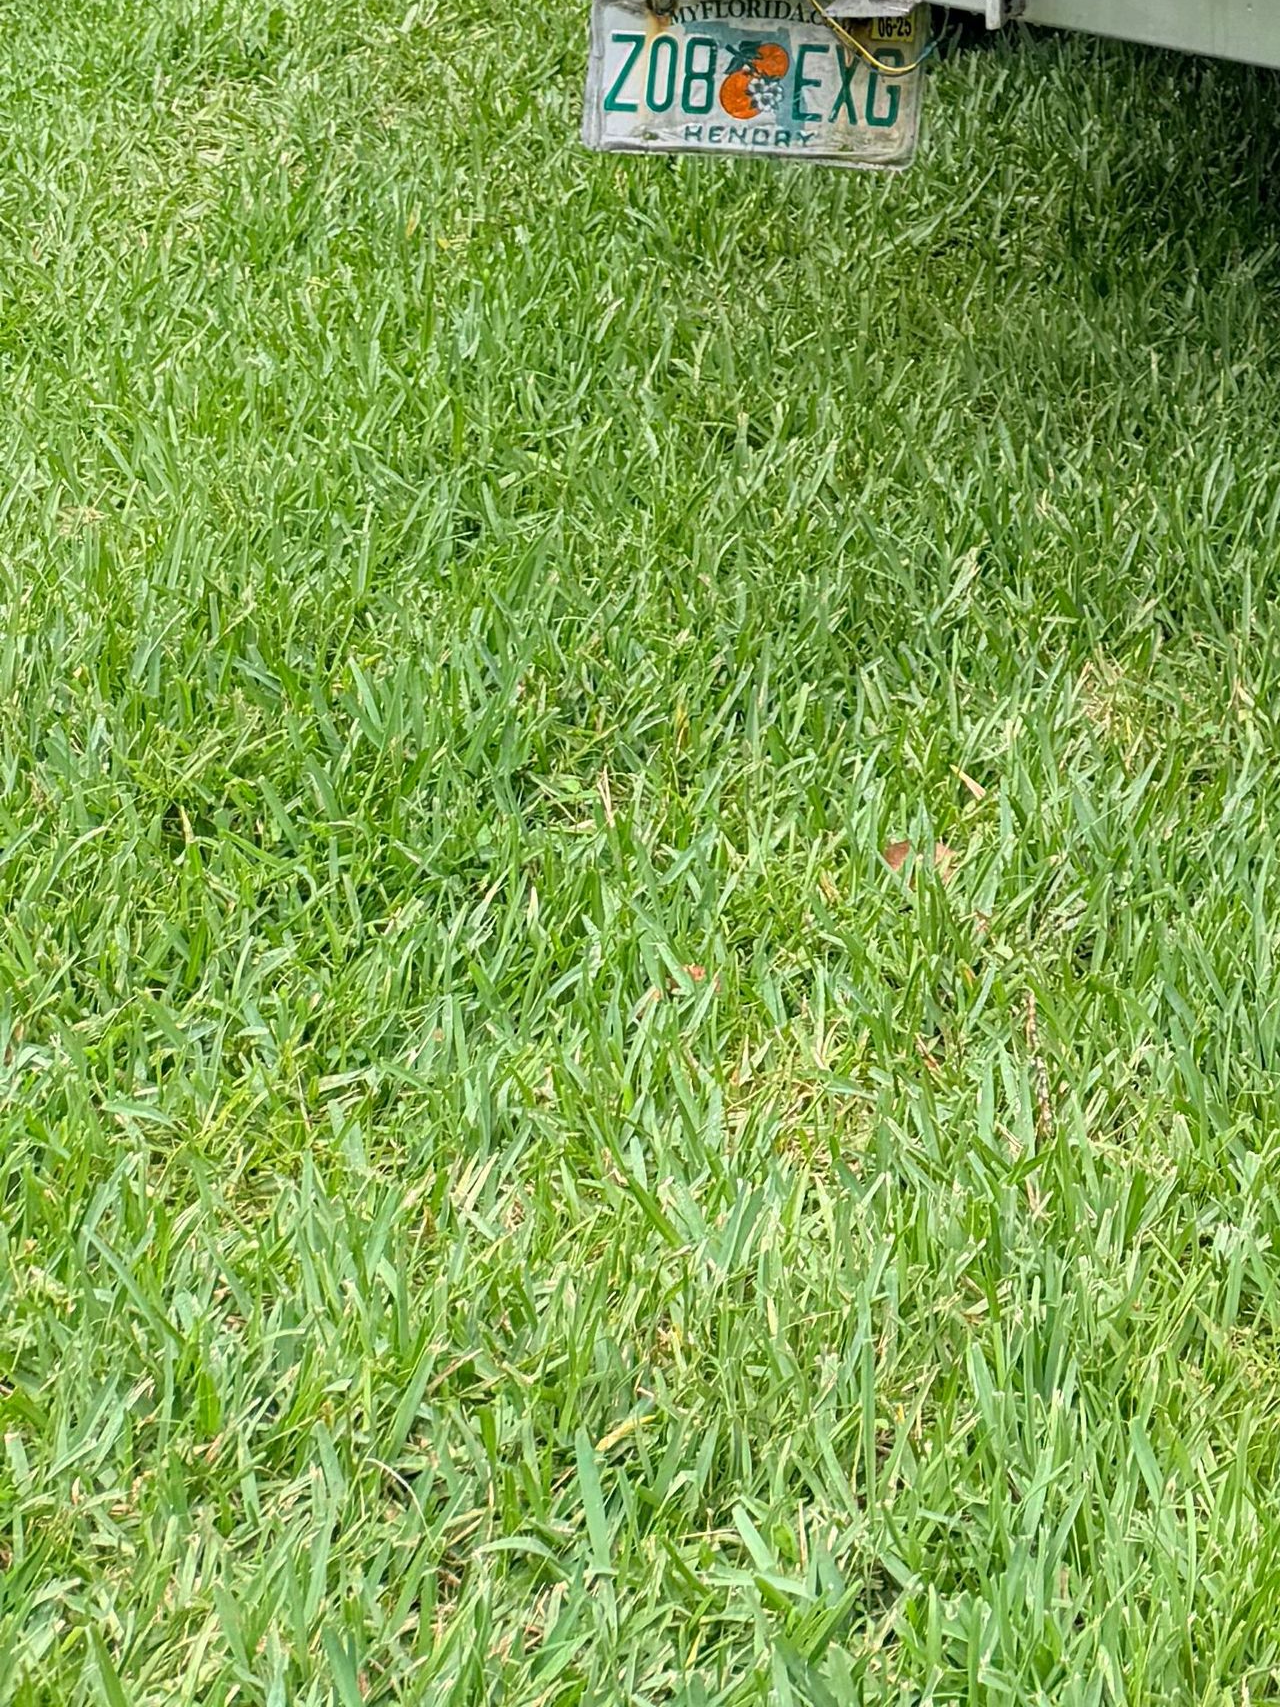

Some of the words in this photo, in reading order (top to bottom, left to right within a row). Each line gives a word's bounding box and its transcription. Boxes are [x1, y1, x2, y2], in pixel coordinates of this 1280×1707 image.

[878, 18, 913, 37] 06-25
[790, 43, 906, 129] EXG
[684, 124, 818, 148] HENDRY
